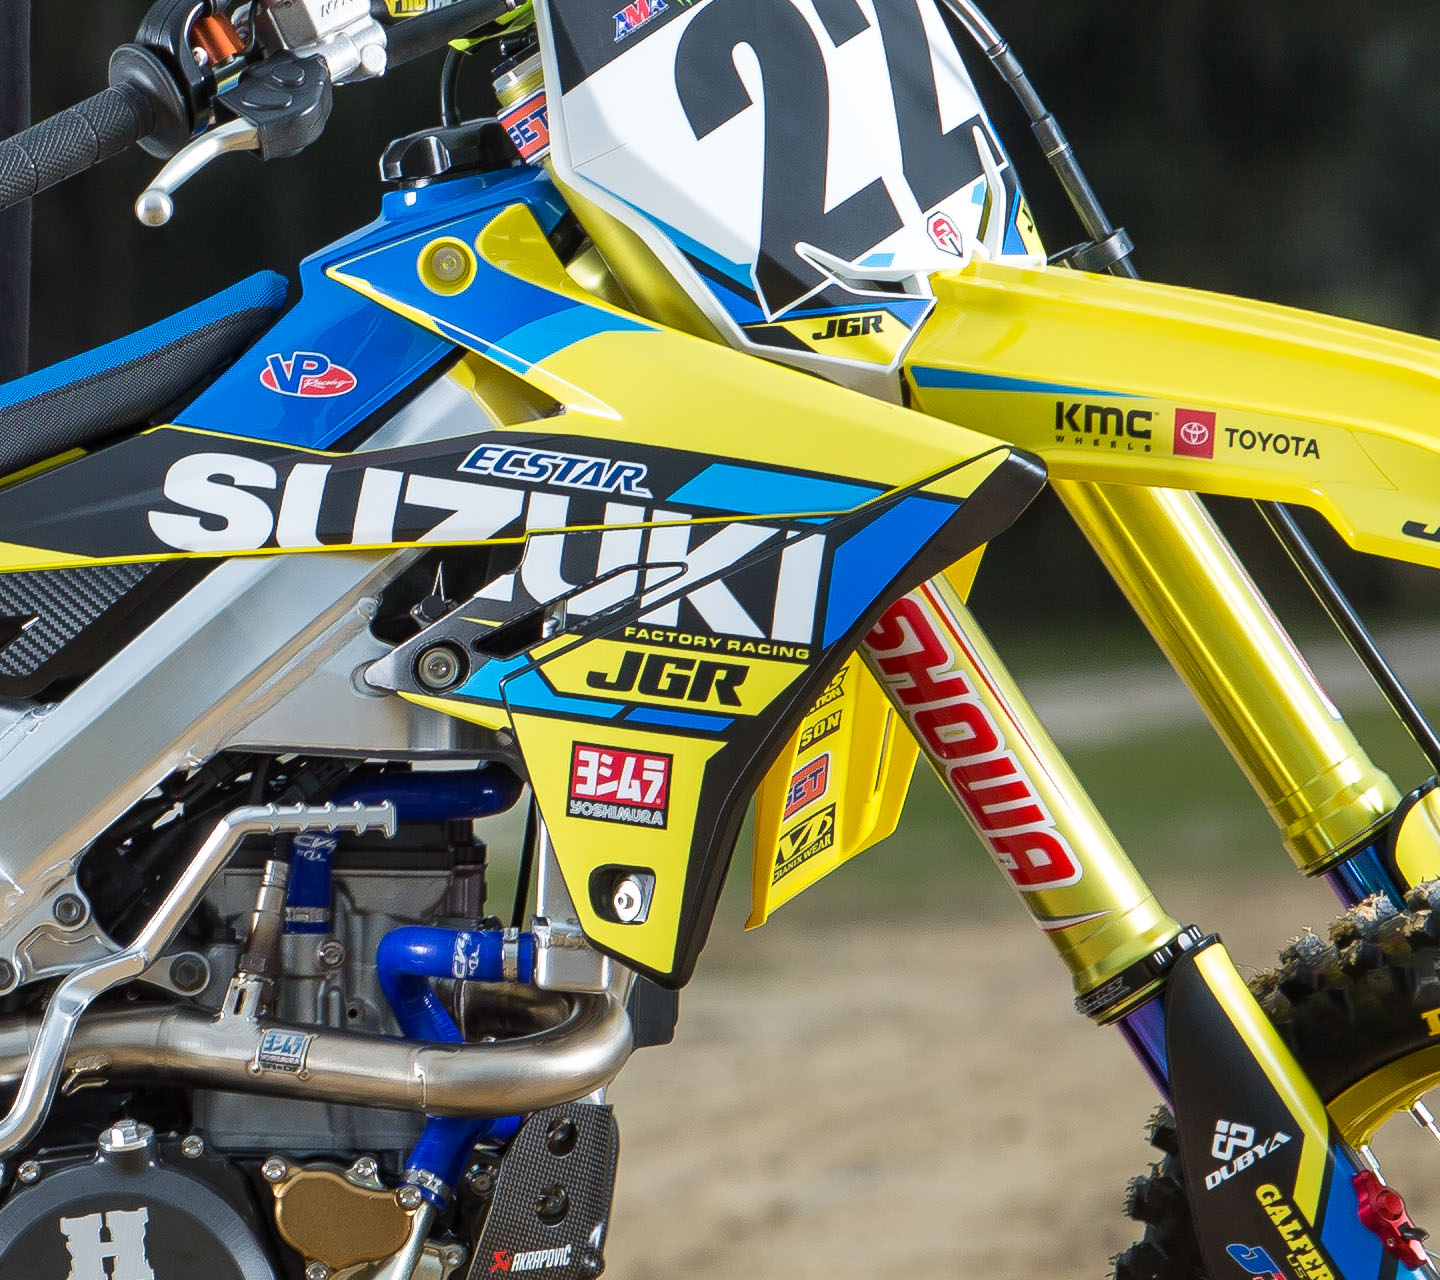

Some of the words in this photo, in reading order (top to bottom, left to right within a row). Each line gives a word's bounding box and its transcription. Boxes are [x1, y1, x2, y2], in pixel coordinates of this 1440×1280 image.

[812, 315, 884, 341] JGR
[266, 351, 331, 395] VP
[1055, 434, 1151, 452] WHEELS
[1225, 427, 1320, 459] TOYOTA
[459, 444, 652, 498] ECSTAR
[147, 452, 829, 644] SUZUKI
[625, 626, 721, 648] FACTORY
[727, 640, 810, 659] RACING
[586, 650, 751, 707] JGR
[865, 591, 1083, 891] SHOWA
[575, 749, 666, 804] ヨシムラ
[570, 800, 664, 825] YOSHIMURA
[804, 834, 832, 861] WEAR
[1204, 1131, 1292, 1191] DUBYA
